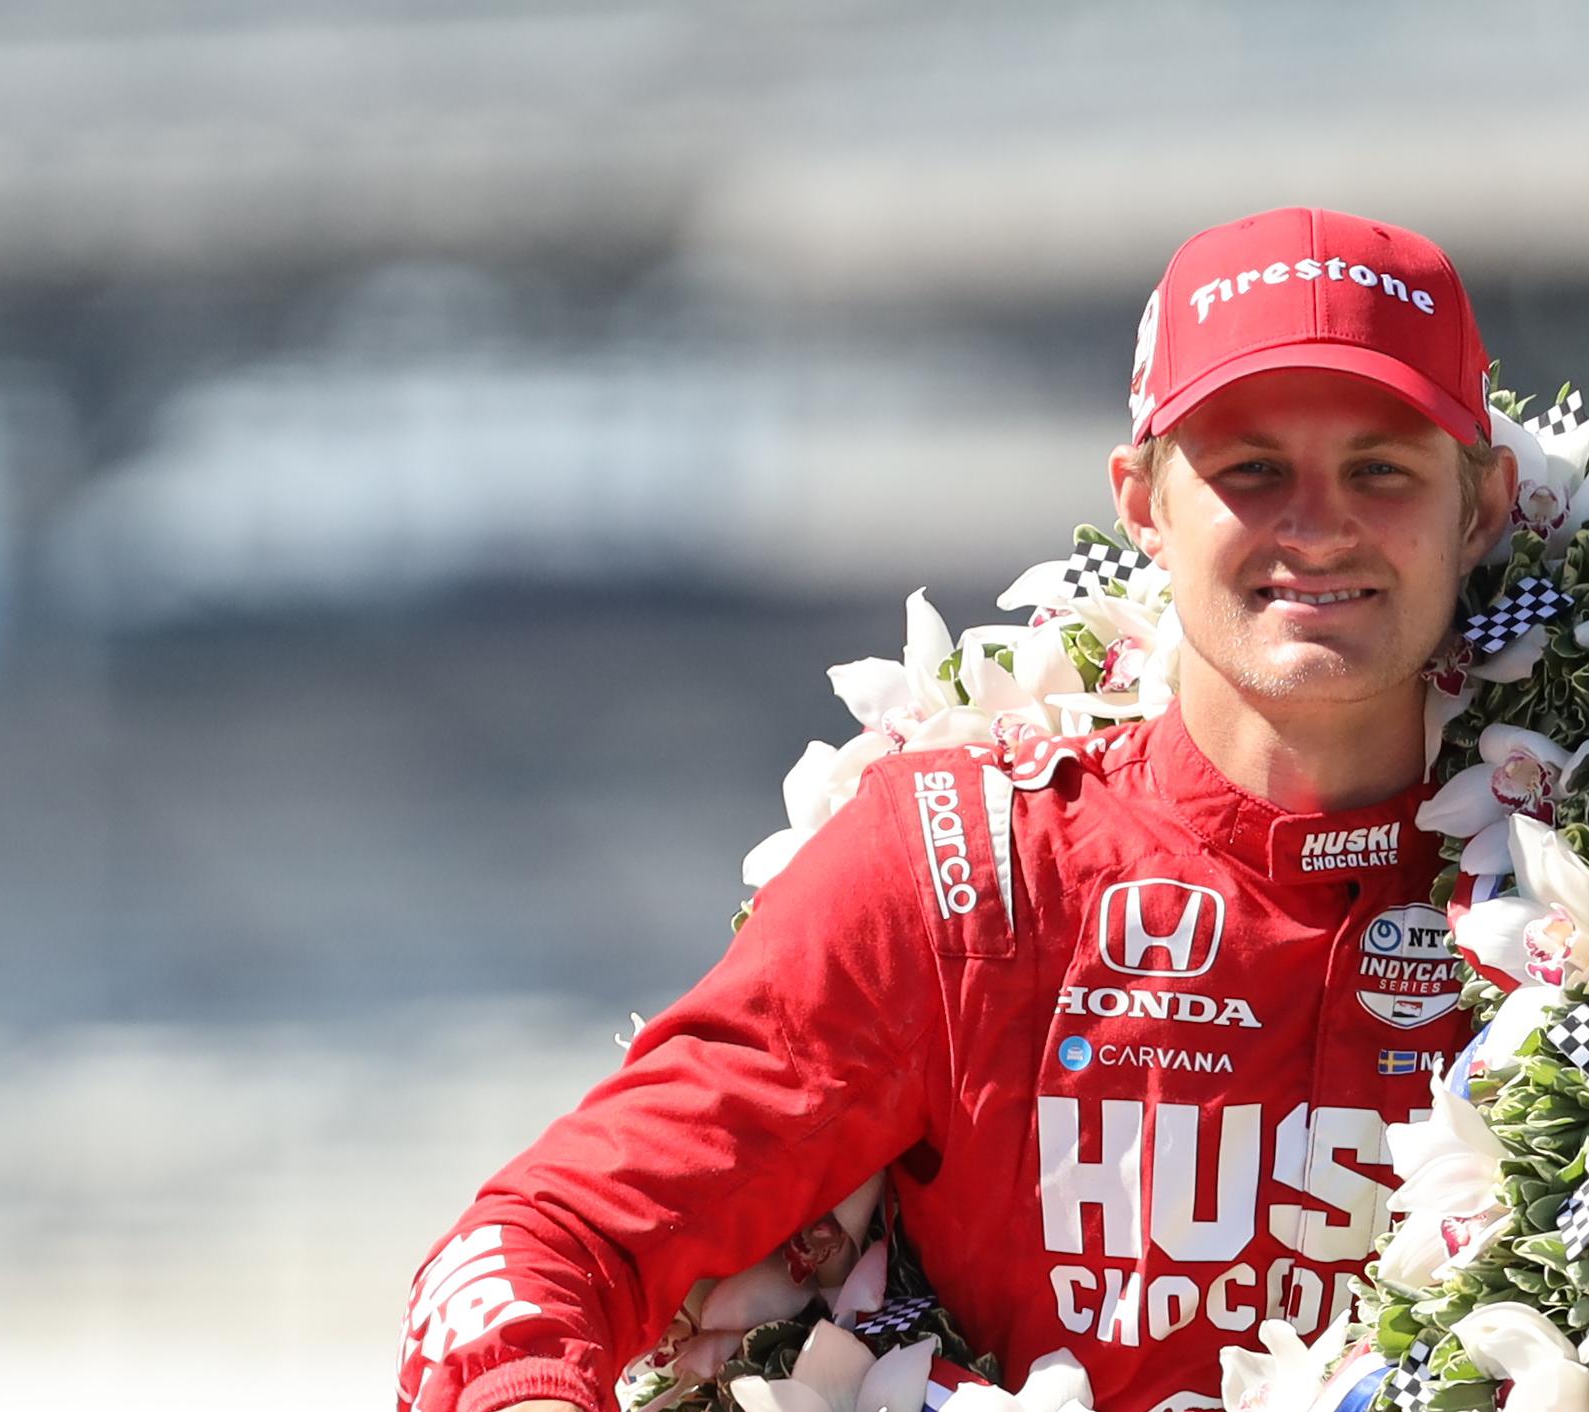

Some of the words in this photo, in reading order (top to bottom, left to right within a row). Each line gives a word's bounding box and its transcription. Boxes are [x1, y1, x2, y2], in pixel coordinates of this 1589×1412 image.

[1189, 257, 1435, 324] Firestone
[914, 770, 978, 920] sparco
[1301, 822, 1401, 857] HUSKI
[1301, 852, 1398, 872] CHOCOLATE
[1360, 956, 1458, 982] INDYCA
[1379, 979, 1442, 993] SERIES
[1056, 987, 1262, 1028] HONDA
[1098, 1045, 1234, 1074] CARVANA
[1038, 1095, 1399, 1262] HUS
[1050, 1264, 1356, 1347] CHOCO
